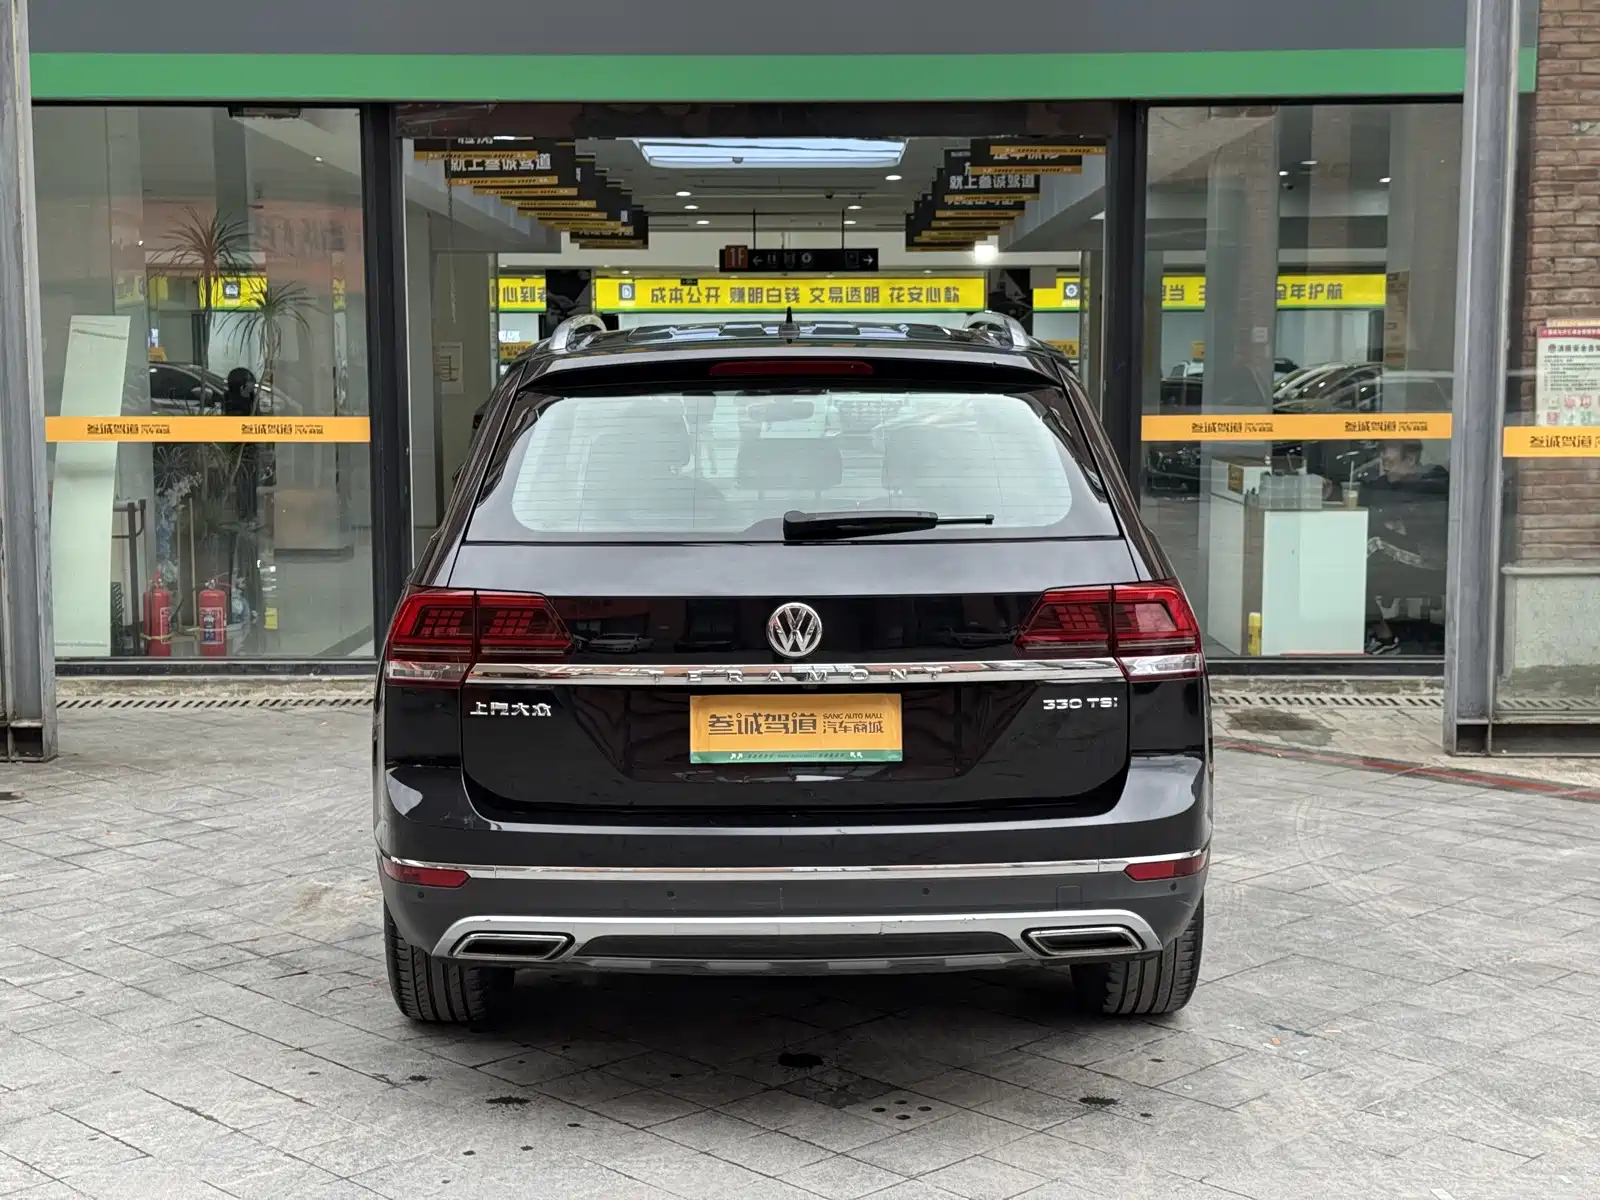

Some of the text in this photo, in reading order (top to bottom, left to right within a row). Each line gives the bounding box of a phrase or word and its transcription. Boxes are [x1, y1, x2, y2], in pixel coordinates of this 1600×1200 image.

[651, 286, 721, 304] 成本公开
[648, 666, 945, 683] TERAMONT
[469, 701, 552, 717] 上汽大众
[1042, 698, 1082, 710] 330
